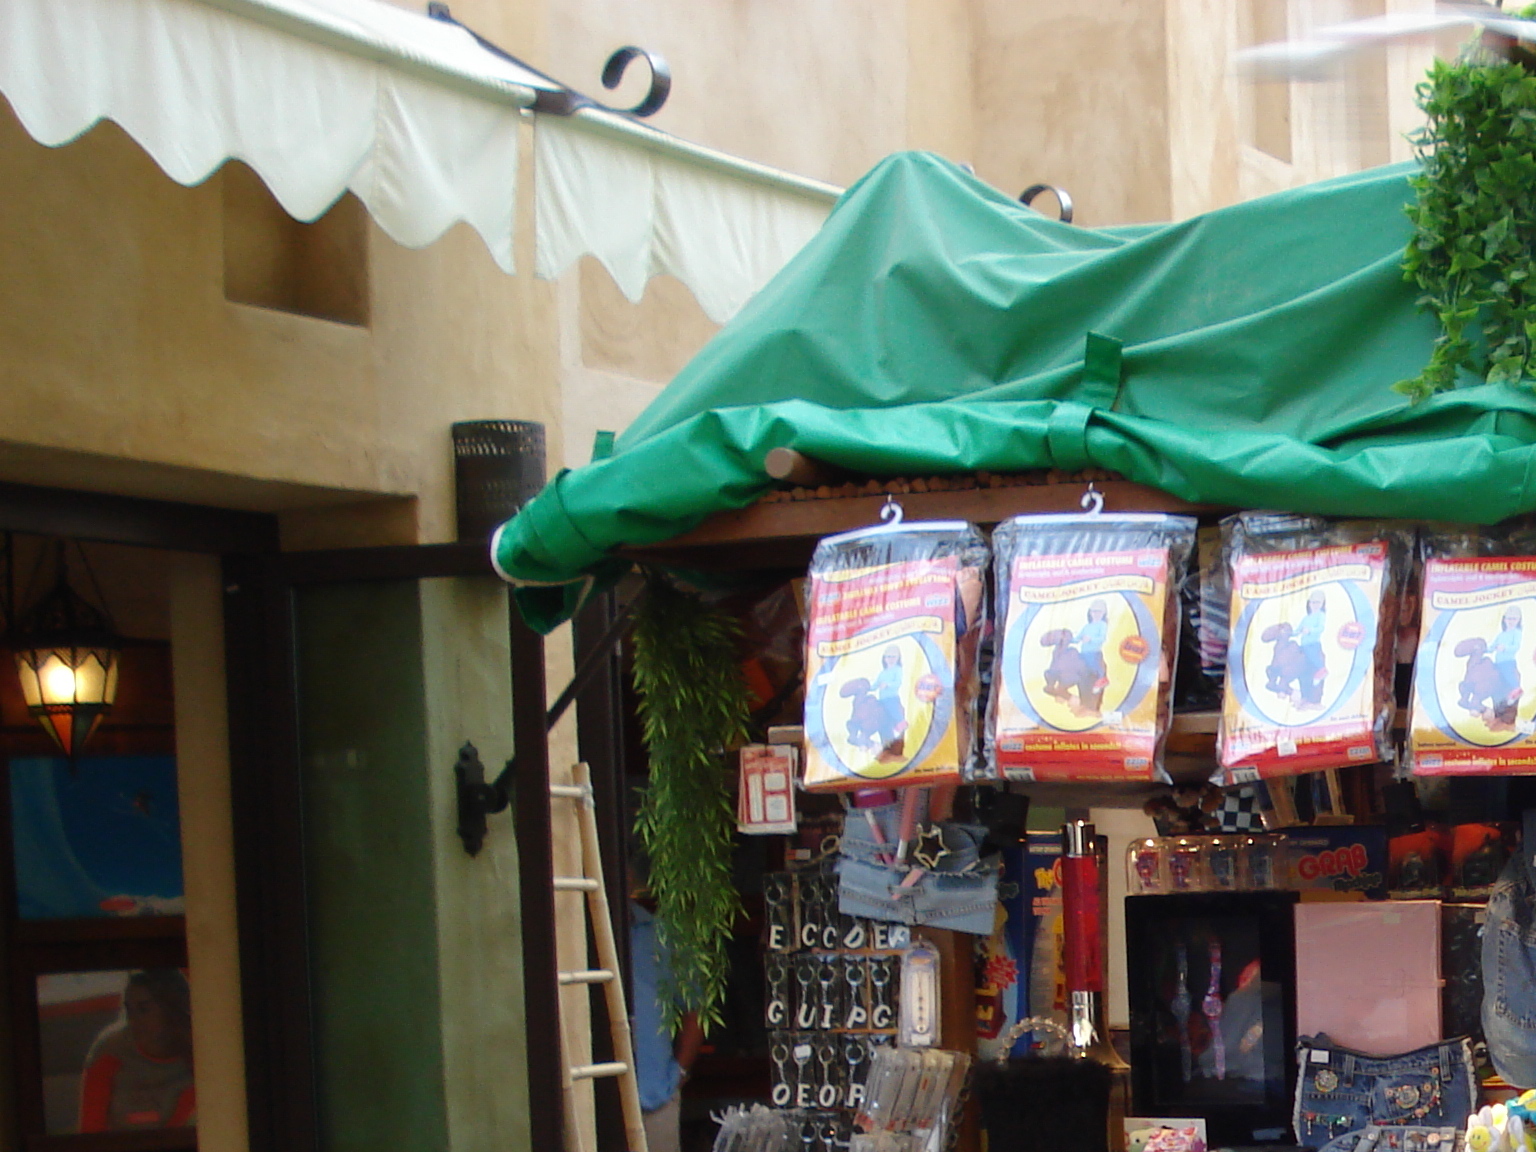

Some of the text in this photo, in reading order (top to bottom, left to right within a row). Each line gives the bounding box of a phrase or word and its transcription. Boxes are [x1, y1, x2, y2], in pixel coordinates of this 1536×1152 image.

[1481, 562, 1507, 572] CAMEL
[1436, 589, 1513, 605] CAMEL JOCKEY
[1298, 843, 1368, 880] GRAB
[769, 923, 889, 949] E C C D E
[768, 1000, 784, 1024] G
[799, 1003, 816, 1028] U
[847, 1005, 867, 1029] P
[873, 1004, 892, 1027] G
[772, 1083, 790, 1106] O
[798, 1083, 811, 1107] E
[819, 1084, 836, 1107] O
